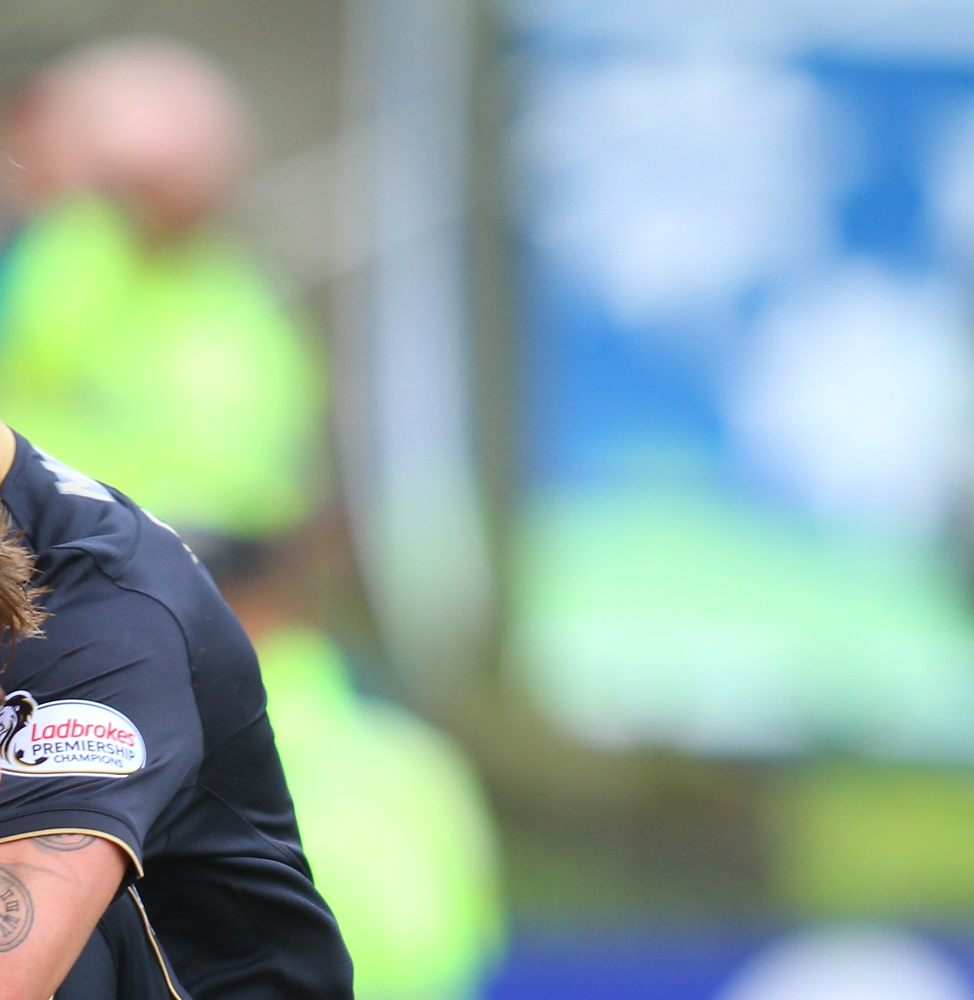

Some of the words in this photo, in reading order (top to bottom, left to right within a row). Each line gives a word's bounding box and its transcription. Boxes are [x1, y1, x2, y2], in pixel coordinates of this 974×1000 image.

[31, 719, 135, 747] Ladbrokes
[32, 740, 136, 761] PREMIERSHIP
[53, 753, 124, 768] CHAMPIONS
